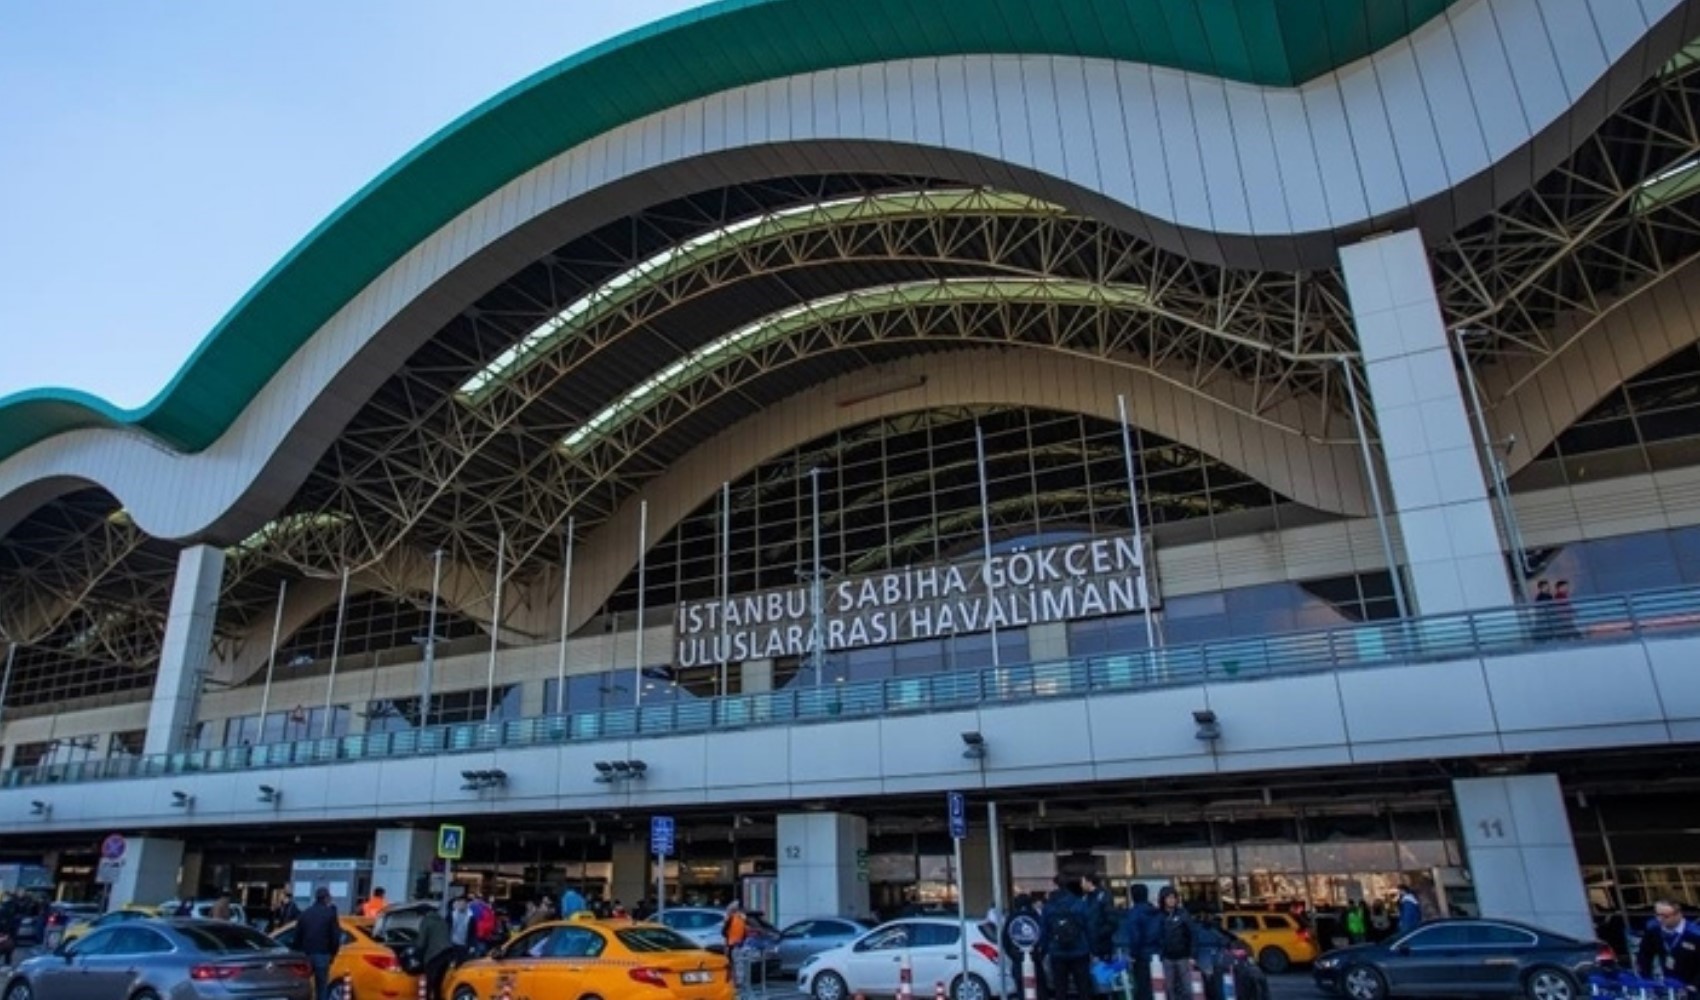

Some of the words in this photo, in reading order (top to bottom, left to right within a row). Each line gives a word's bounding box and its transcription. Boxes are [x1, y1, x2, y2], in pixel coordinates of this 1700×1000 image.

[838, 564, 967, 611] SABİHA
[982, 535, 1142, 587] GÖKÇEN
[680, 611, 897, 667] ULUSLARARASI
[910, 576, 1148, 637] HAVALİMANI
[785, 845, 800, 858] 12
[1479, 819, 1504, 838] 11
